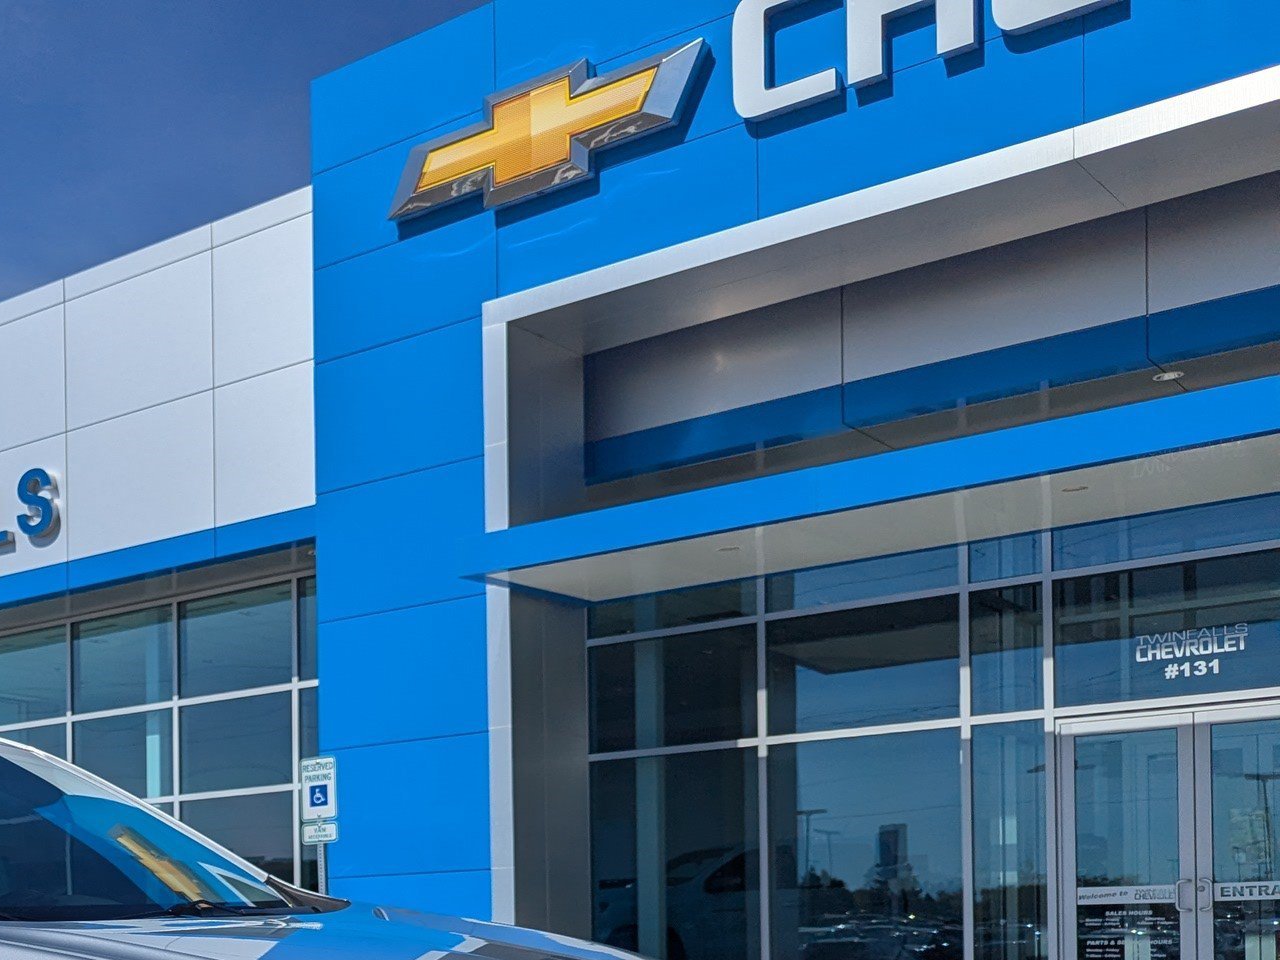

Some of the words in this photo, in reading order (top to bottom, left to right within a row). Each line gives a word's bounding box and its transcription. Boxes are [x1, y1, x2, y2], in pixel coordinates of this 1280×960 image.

[1135, 633, 1249, 663] CHEVROLET
[1164, 658, 1220, 680] #131
[302, 762, 334, 773] RESERVED
[304, 773, 332, 783] PARKING
[1078, 891, 1117, 900] Welcome
